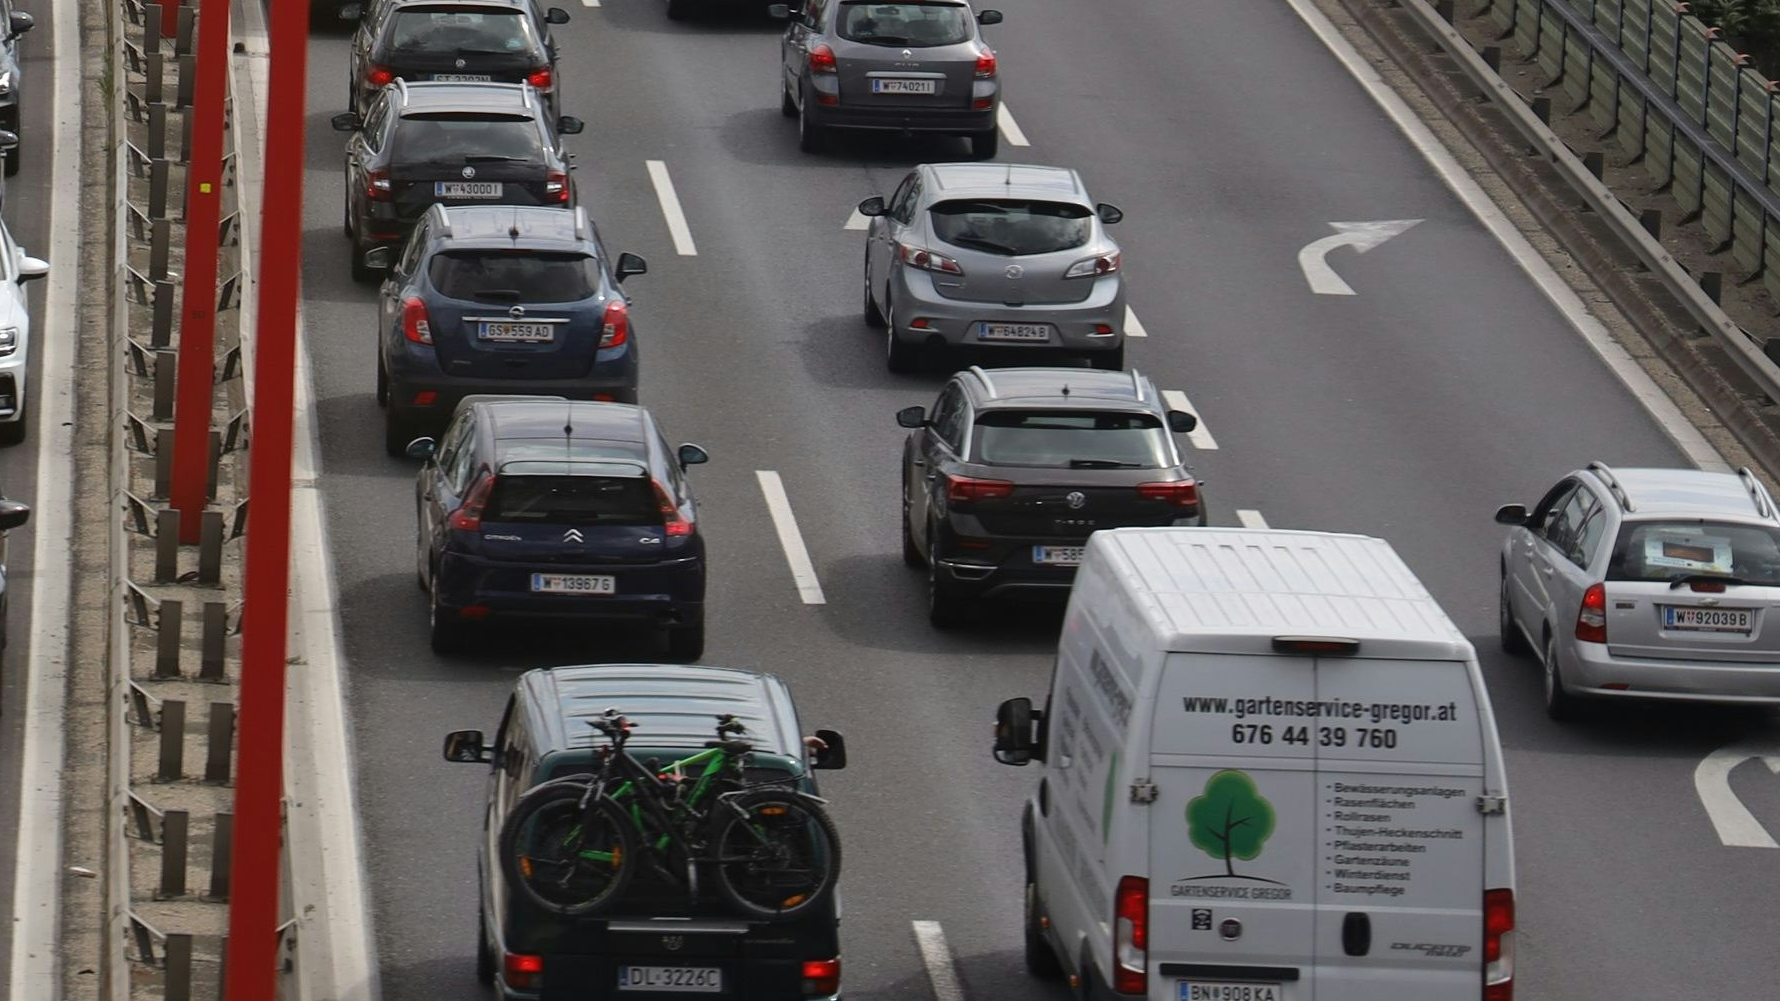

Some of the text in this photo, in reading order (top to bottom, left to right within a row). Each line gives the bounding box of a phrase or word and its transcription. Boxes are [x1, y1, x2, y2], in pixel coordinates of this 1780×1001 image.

[1676, 611, 1686, 624] W
[1696, 611, 1737, 626] 92039
[1182, 696, 1457, 725] www.gartenservice-gregor.at
[1231, 724, 1397, 749] 676 44 39 760
[1334, 810, 1392, 823] Rollrasen
[1334, 869, 1411, 881] Winterdienst
[1170, 885, 1292, 901] GARTENSERVICE GREGOR
[1334, 882, 1406, 897] Baumpflege
[1191, 985, 1276, 1001] BN 908 KA
